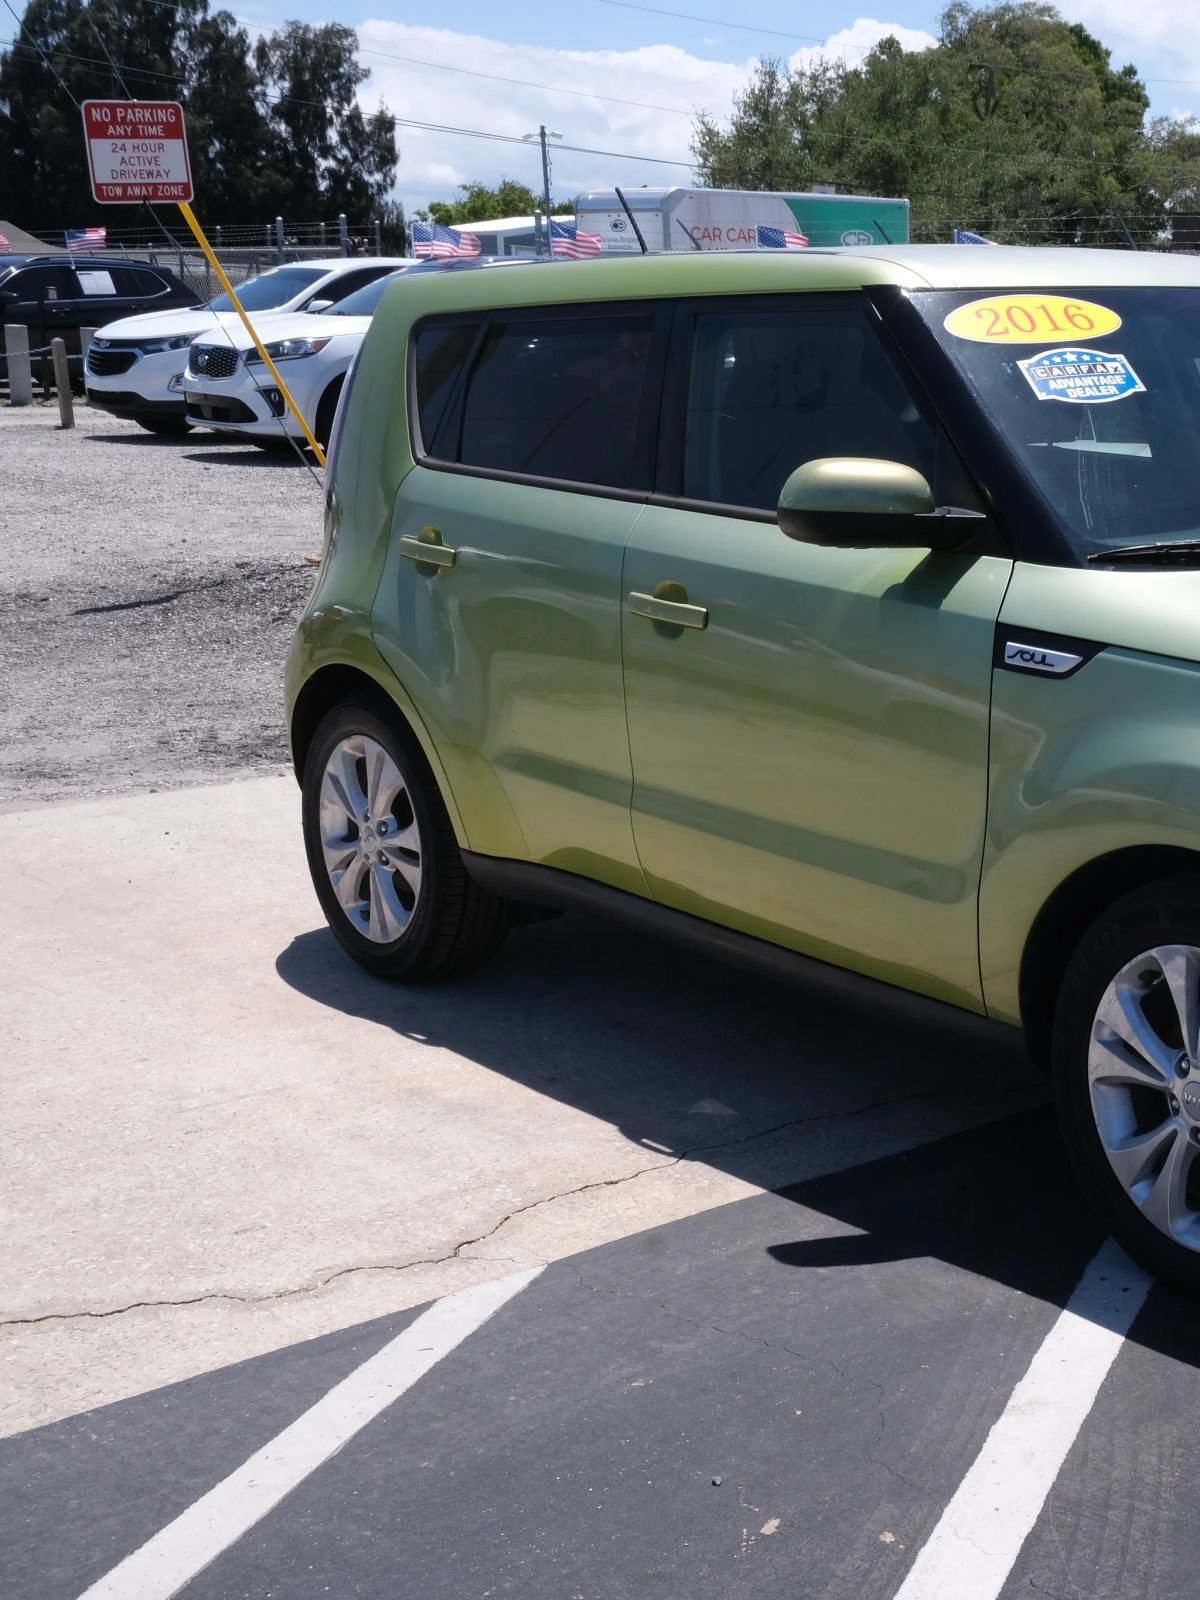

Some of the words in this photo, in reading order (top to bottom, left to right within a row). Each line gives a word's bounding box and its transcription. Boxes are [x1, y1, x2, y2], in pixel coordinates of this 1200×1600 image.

[91, 108, 111, 122] NO
[116, 108, 176, 122] PARKING
[107, 125, 132, 136] ANY
[137, 125, 165, 136] TIME
[111, 142, 127, 153] 24
[132, 143, 165, 153] HOUR
[119, 156, 160, 166] ACTIVE
[111, 169, 171, 180] DRIVEWAY
[101, 186, 122, 196] TOW
[127, 186, 154, 196] AWAY
[158, 185, 184, 196] ZONE
[690, 226, 722, 242] CAR
[726, 228, 756, 243] CAR
[975, 304, 1095, 337] 2016
[1034, 363, 1124, 379] CARFAX
[1048, 375, 1125, 390] ADVANTAGE
[1066, 386, 1119, 398] DEALER
[1007, 650, 1055, 667] SOUL
